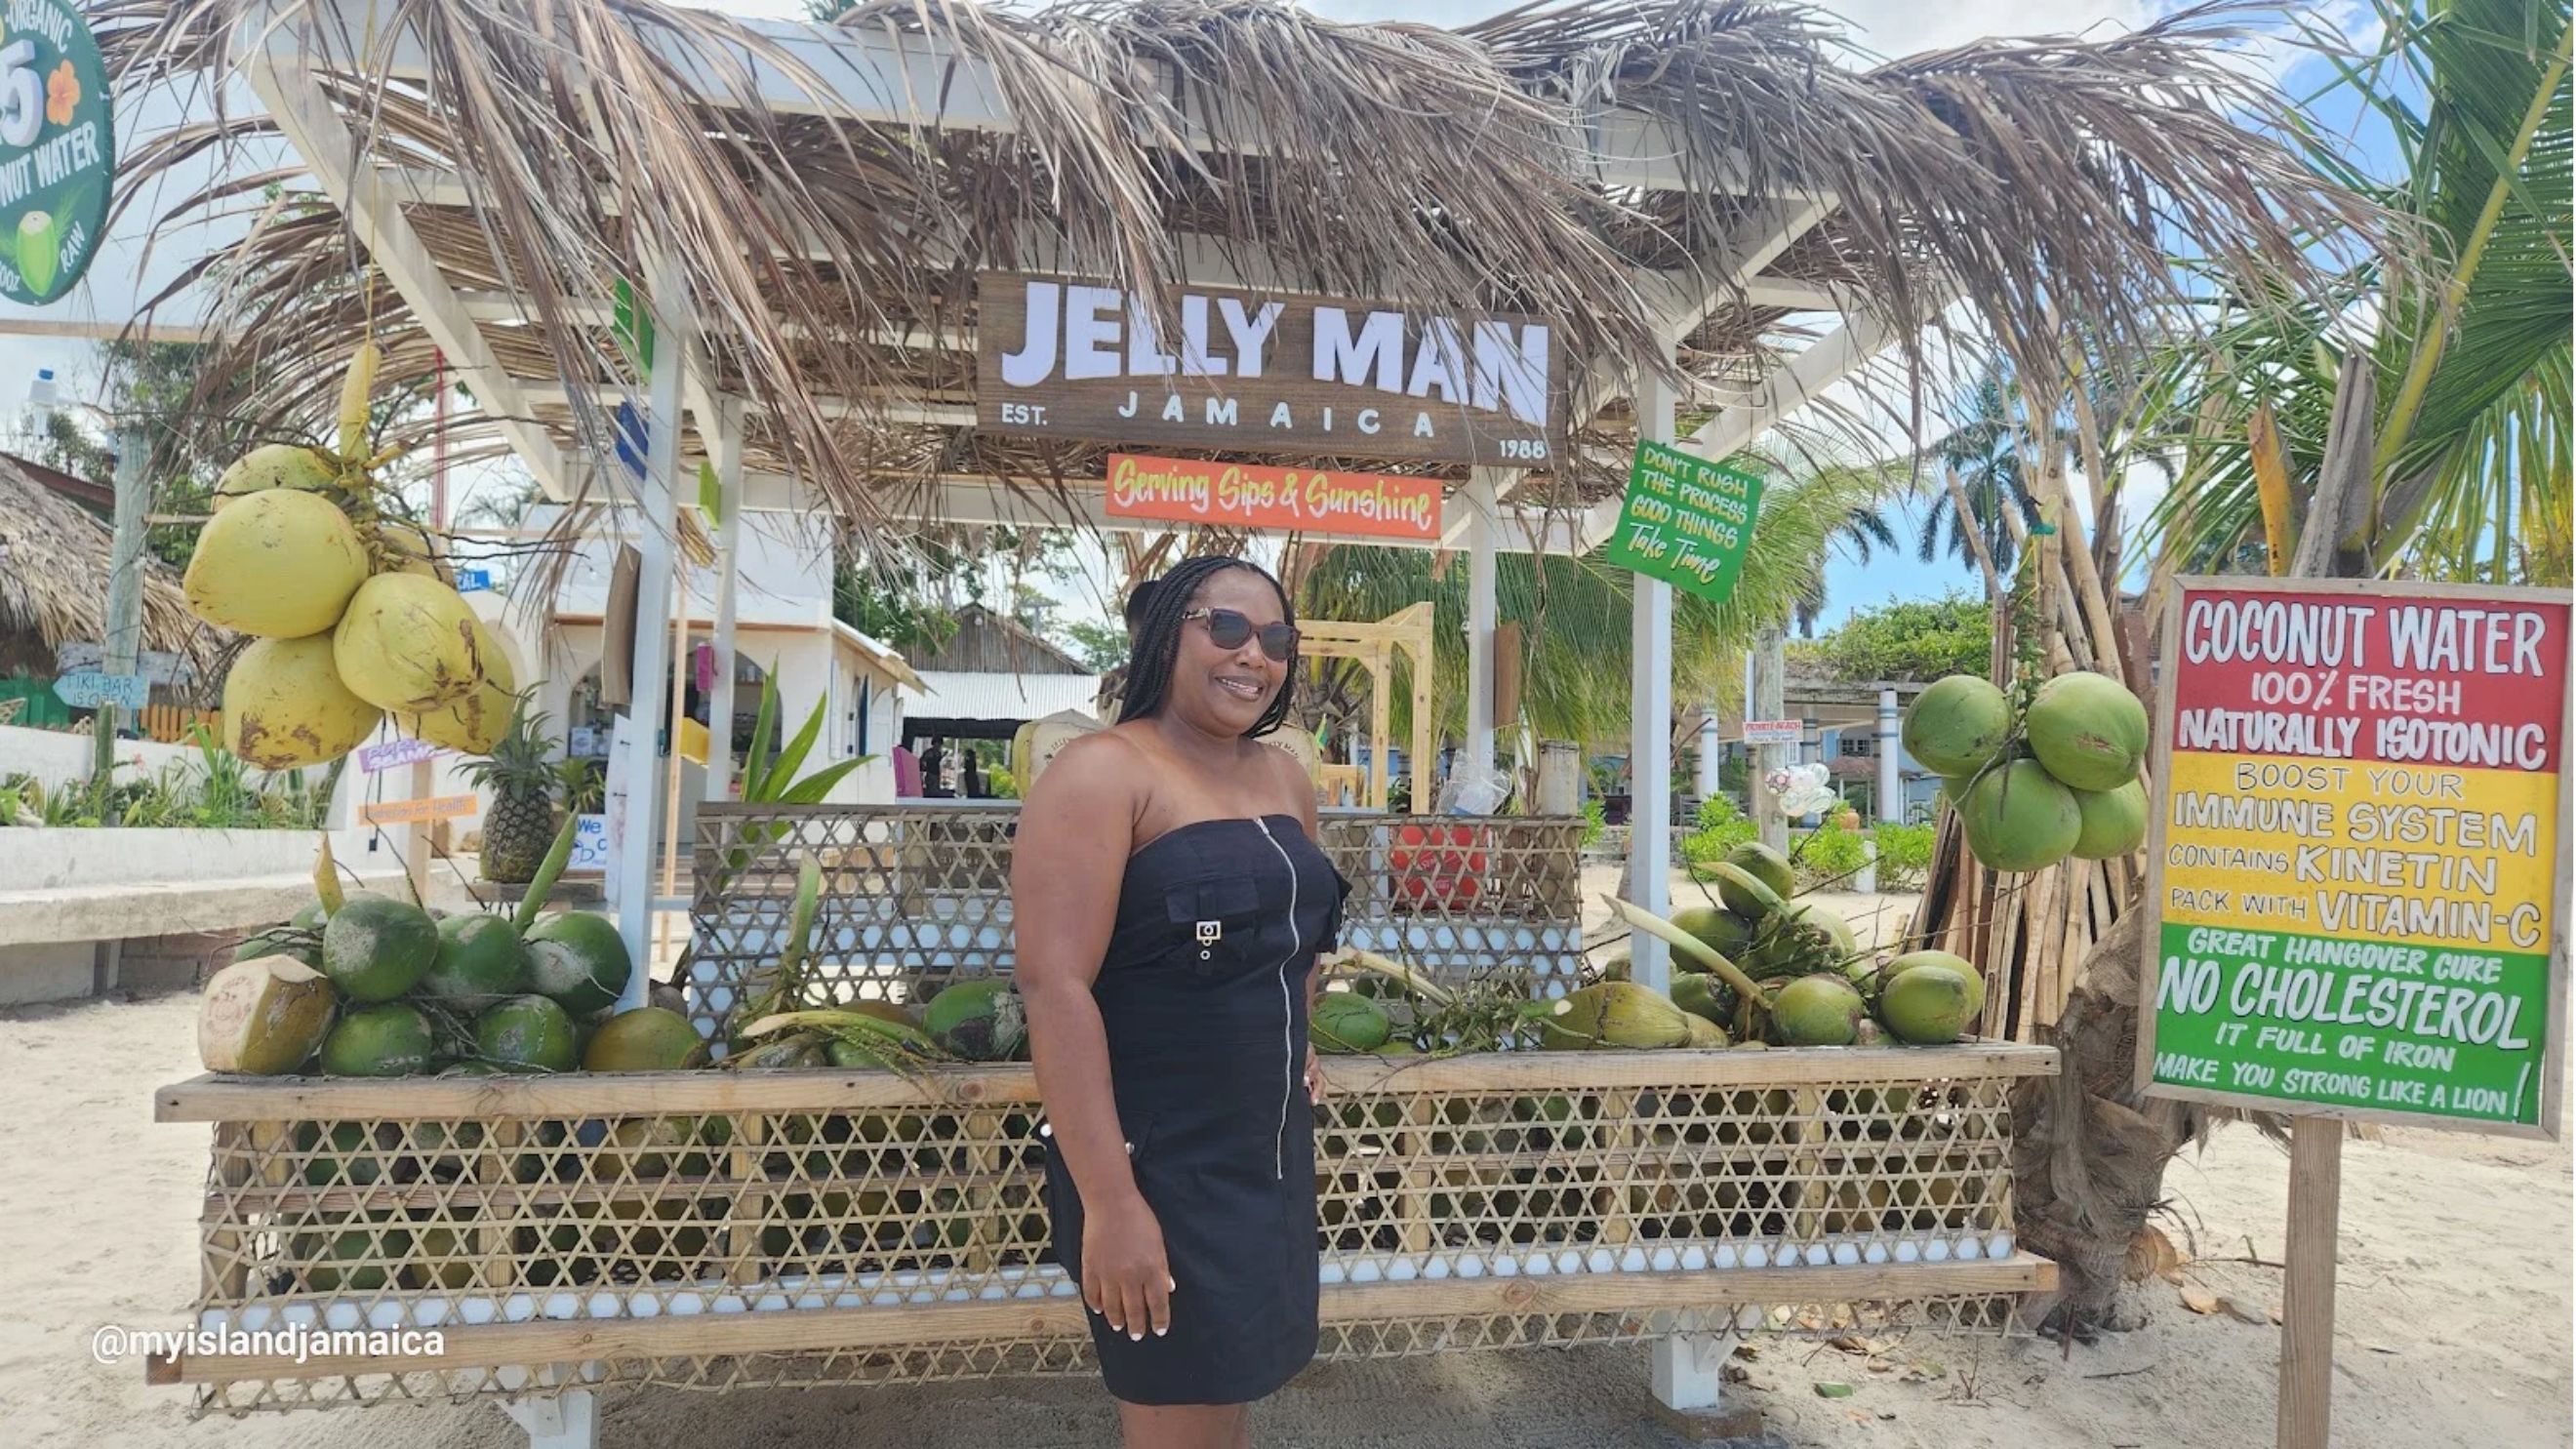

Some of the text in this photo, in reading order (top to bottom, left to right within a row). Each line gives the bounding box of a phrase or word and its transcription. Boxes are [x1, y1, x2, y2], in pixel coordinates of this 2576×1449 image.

[34, 120, 100, 188] WATER
[60, 221, 85, 273] RAW
[1002, 282, 1549, 427] JELLY MAN
[1002, 402, 1048, 426] EST.
[1118, 391, 1434, 437] JAMAICA
[1500, 439, 1547, 460] 1988
[1643, 447, 1749, 500] DON'T RUSH
[1114, 459, 1431, 531] Serving Sips & Sunshine
[1630, 494, 1738, 550] GOOD THINGS
[1641, 469, 1748, 525] THE PROCESS
[1628, 522, 1721, 584] Take Time
[2185, 599, 2547, 677] COCONUT WATER
[2251, 669, 2461, 715] 100% FRESH
[2179, 706, 2548, 771] NATURALLY ISOTONIC
[2234, 762, 2466, 801] BOOST YOUR
[2174, 790, 2538, 857] IMMUNE SYSTEM
[2167, 843, 2497, 896] CONTAINS KINETIN
[2171, 887, 2541, 948] PACK WITH VITAMIN-C
[2187, 926, 2503, 984] GREAT HANGOVER CURE
[2156, 954, 2530, 1051] NO CHOLESTEROL
[2215, 1022, 2457, 1072] IT FULL OF IRON
[2153, 1051, 2219, 1083] MAKE
[2232, 1061, 2275, 1089] YOU
[2281, 1067, 2371, 1099] STRONG
[2377, 1078, 2426, 1106] LIKE
[2430, 1083, 2446, 1108] A
